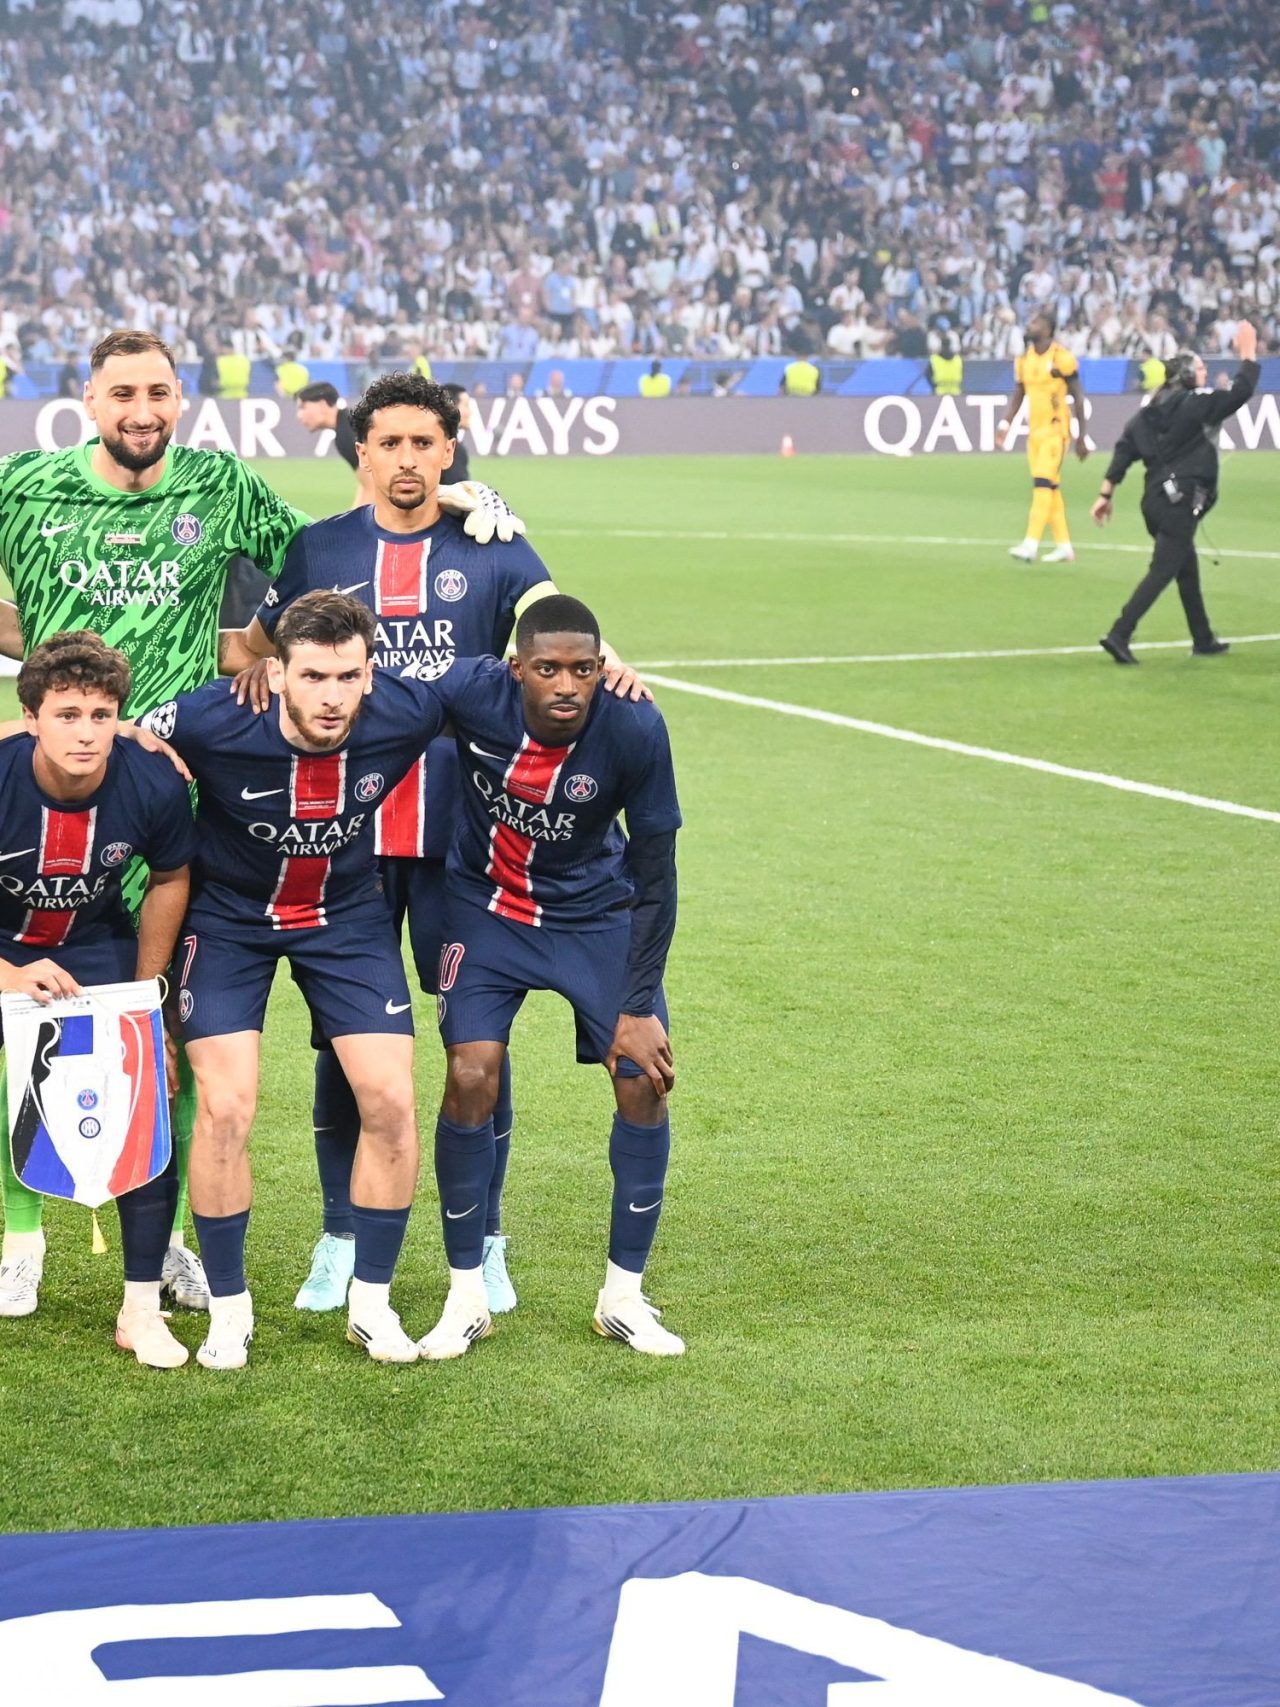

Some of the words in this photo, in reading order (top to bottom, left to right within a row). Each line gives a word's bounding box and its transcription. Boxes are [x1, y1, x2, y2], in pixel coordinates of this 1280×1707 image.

[60, 560, 181, 593] QATAR
[90, 589, 181, 607] AIRWAYS
[373, 619, 456, 649] ATAR
[571, 775, 595, 786] PARIS
[473, 770, 577, 830] QATAR
[248, 813, 367, 844] QATAR
[488, 805, 573, 842] AIRWAYS
[180, 935, 198, 990] 7
